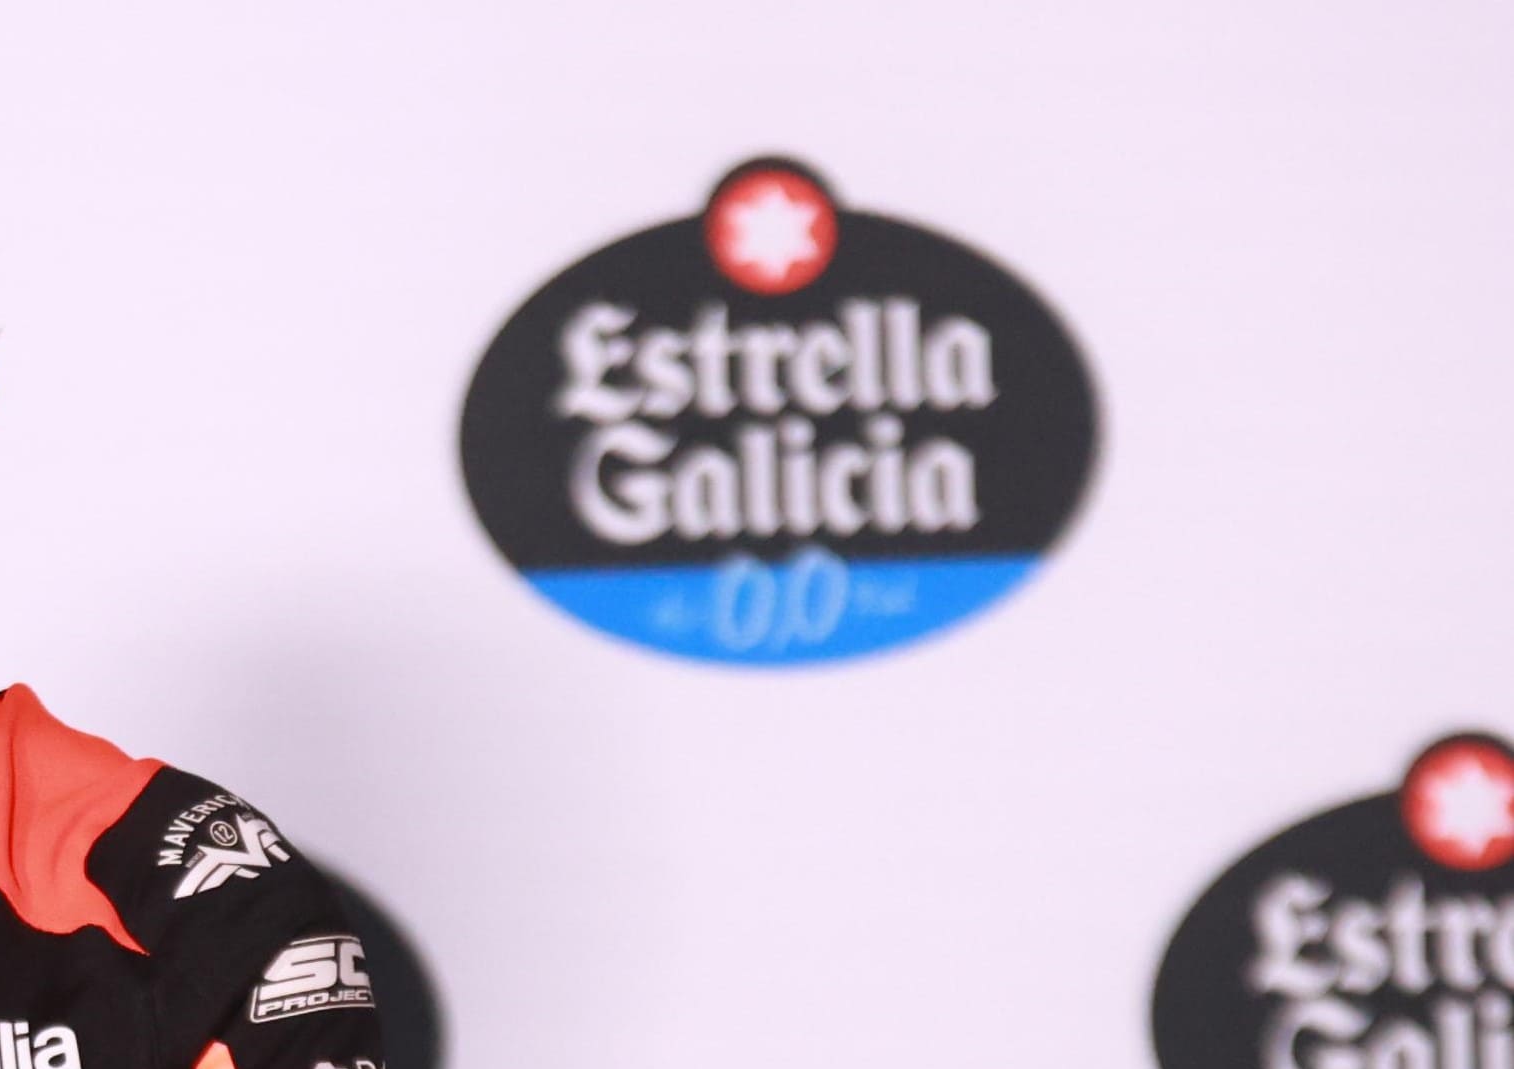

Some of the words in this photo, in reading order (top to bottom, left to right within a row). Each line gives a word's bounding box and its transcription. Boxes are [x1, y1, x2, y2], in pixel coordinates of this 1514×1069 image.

[554, 298, 998, 421] Estrella
[569, 414, 980, 546] Galicia
[213, 824, 235, 843] 12
[1245, 870, 1514, 998] Estr
[257, 990, 374, 1017] PROJEC
